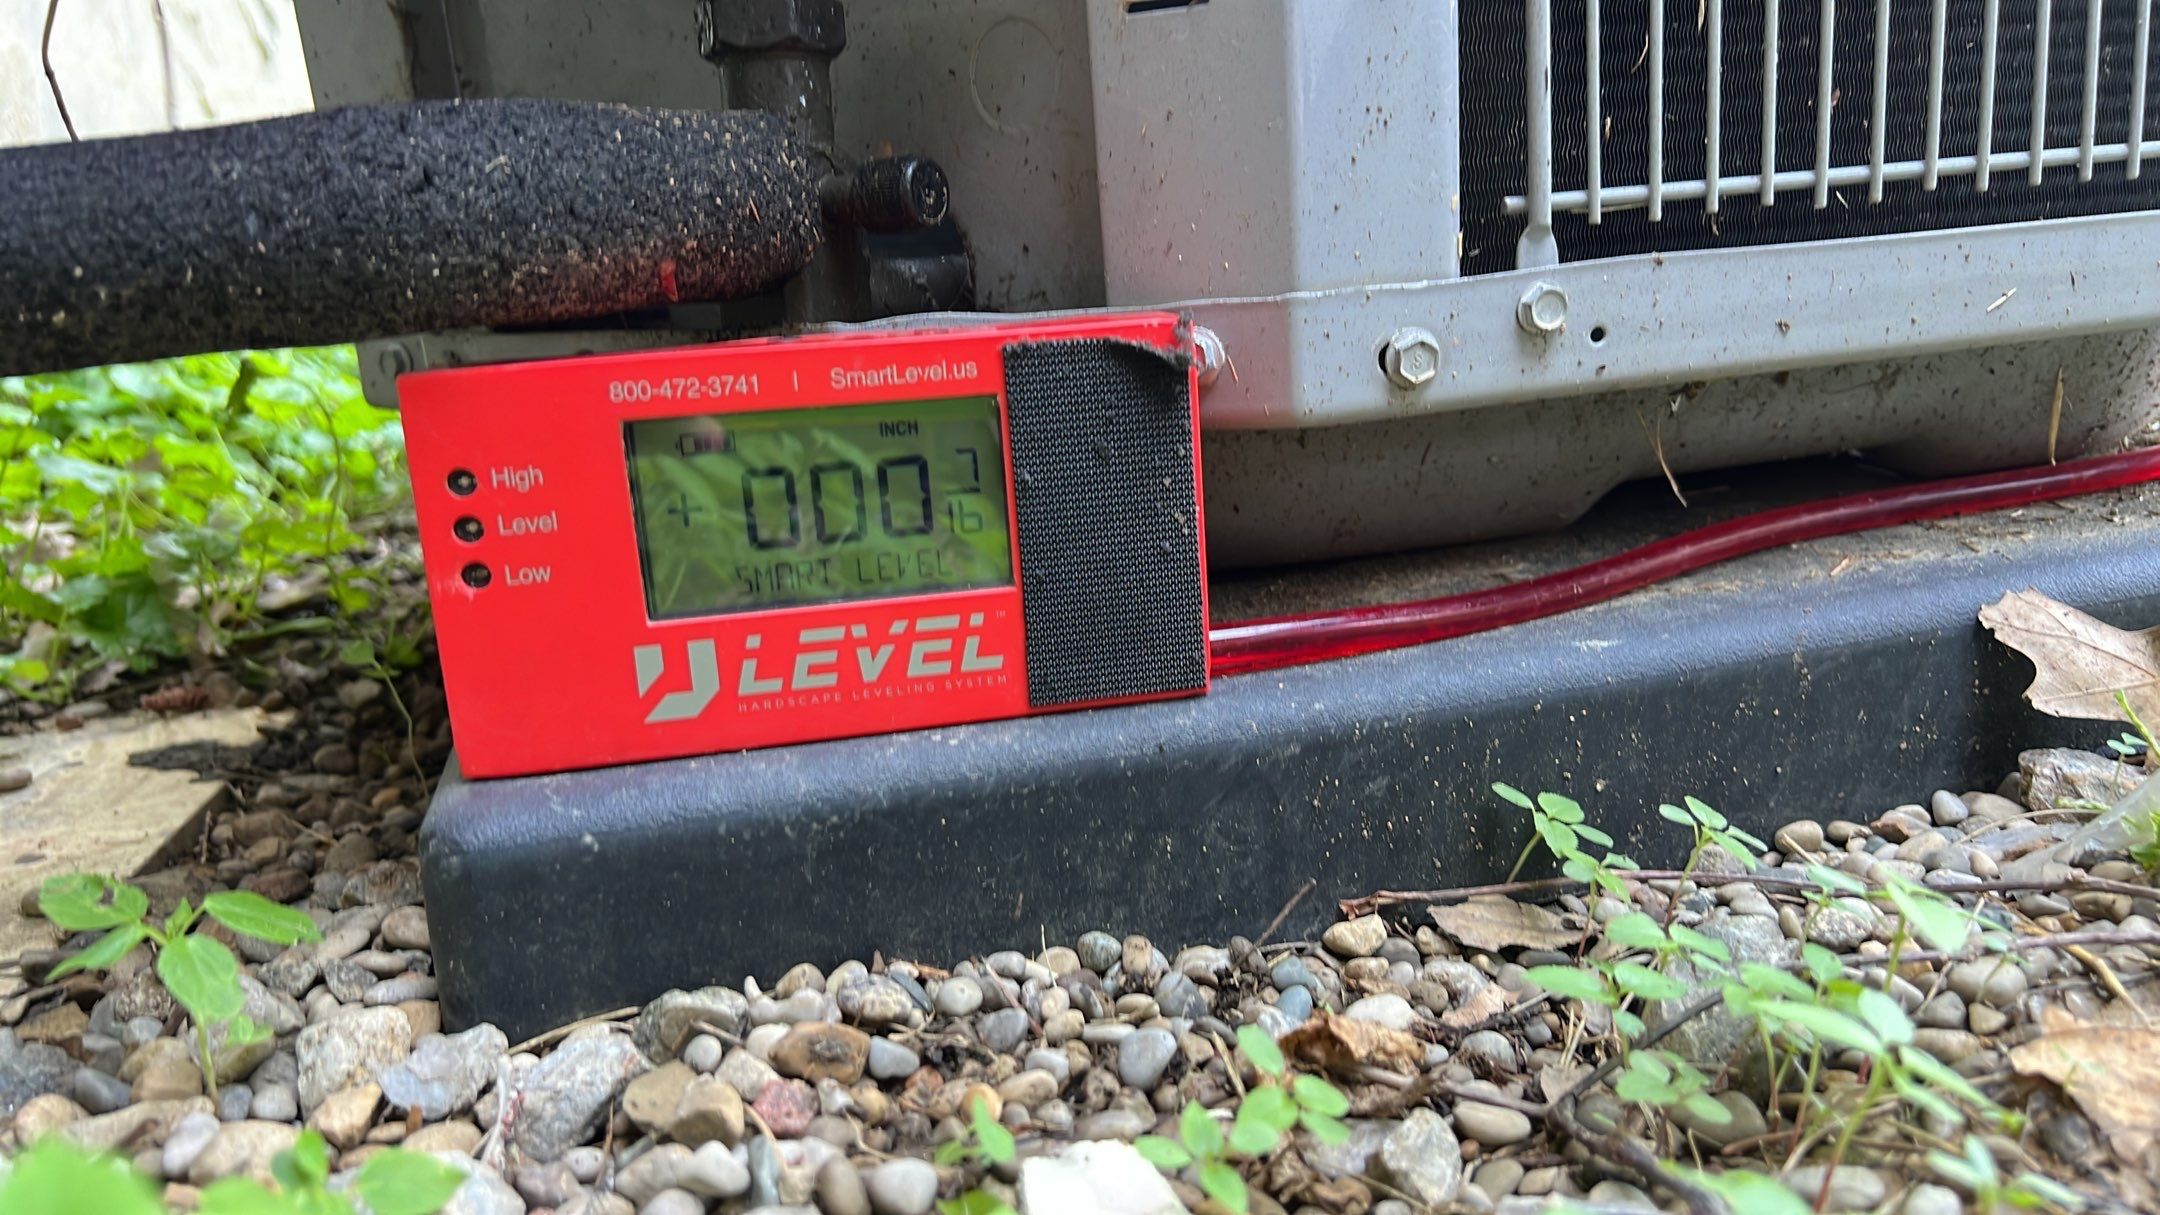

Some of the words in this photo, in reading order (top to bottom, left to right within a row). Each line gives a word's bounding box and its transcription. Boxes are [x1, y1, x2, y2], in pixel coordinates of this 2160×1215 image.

[609, 374, 760, 403] 800-472-3741
[830, 360, 977, 390] SmartLevel.us
[880, 420, 919, 437] INCH
[491, 465, 544, 493] High
[497, 510, 558, 536] Level
[505, 565, 551, 587] Low
[736, 558, 831, 595] SMART
[857, 550, 953, 584] LEVEL
[737, 612, 1004, 697] LEVEL
[737, 691, 843, 713] HARDSCAPE
[851, 681, 936, 701] LEVELING
[944, 674, 1008, 691] SYSTEM
